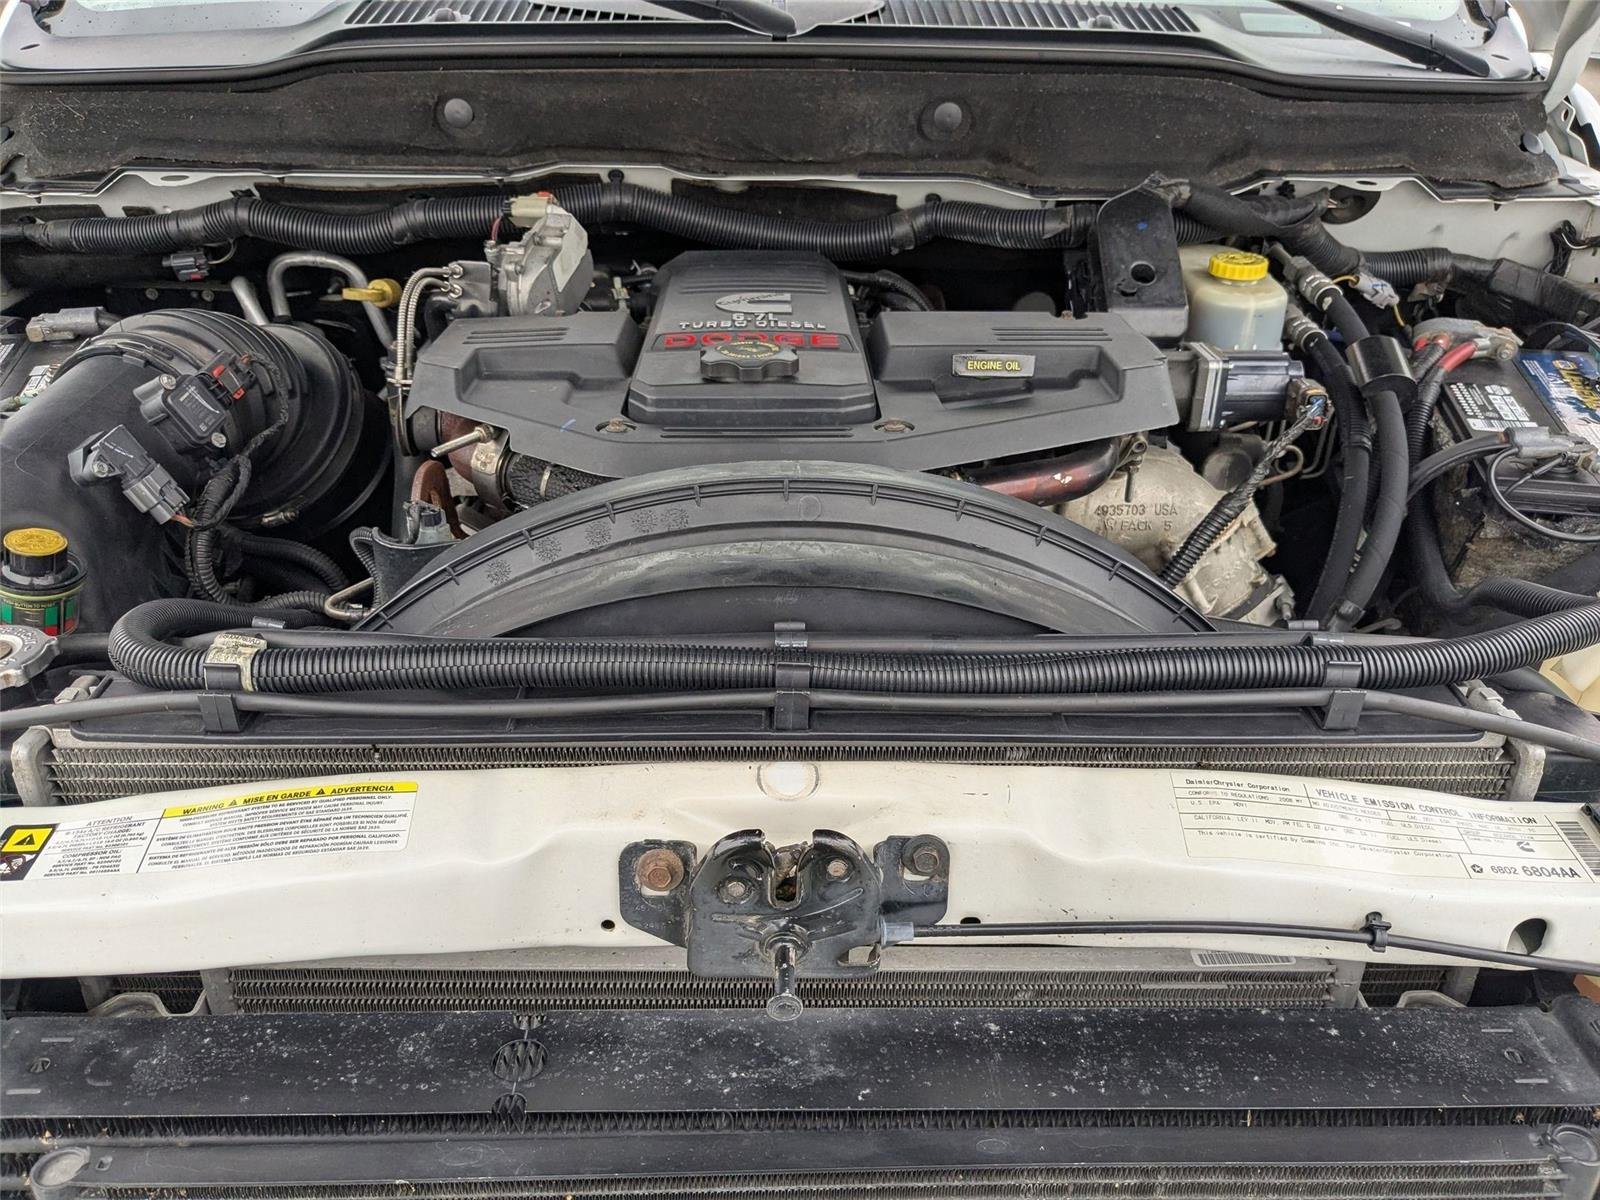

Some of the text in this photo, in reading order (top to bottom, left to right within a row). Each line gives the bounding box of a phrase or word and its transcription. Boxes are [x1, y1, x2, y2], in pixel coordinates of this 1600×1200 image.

[680, 320, 826, 329] TURBO DIESEL
[664, 333, 841, 348] DODGE
[967, 360, 1021, 370] ENGINE OIL
[1154, 503, 1178, 516] USA
[1186, 779, 1290, 793] DaimlerChrysler Corporation
[182, 802, 224, 815] WARNING
[243, 797, 264, 805] MISE
[281, 791, 312, 800] GARDE
[330, 785, 394, 795] ADVERTENCIA
[1316, 789, 1360, 803] VEHICLE
[1363, 796, 1415, 812] EMISSION
[1419, 804, 1463, 818] CONTROL
[1469, 812, 1538, 825] INFORMATION
[86, 815, 133, 827] ATTENTION
[1522, 865, 1582, 878] 6804AA
